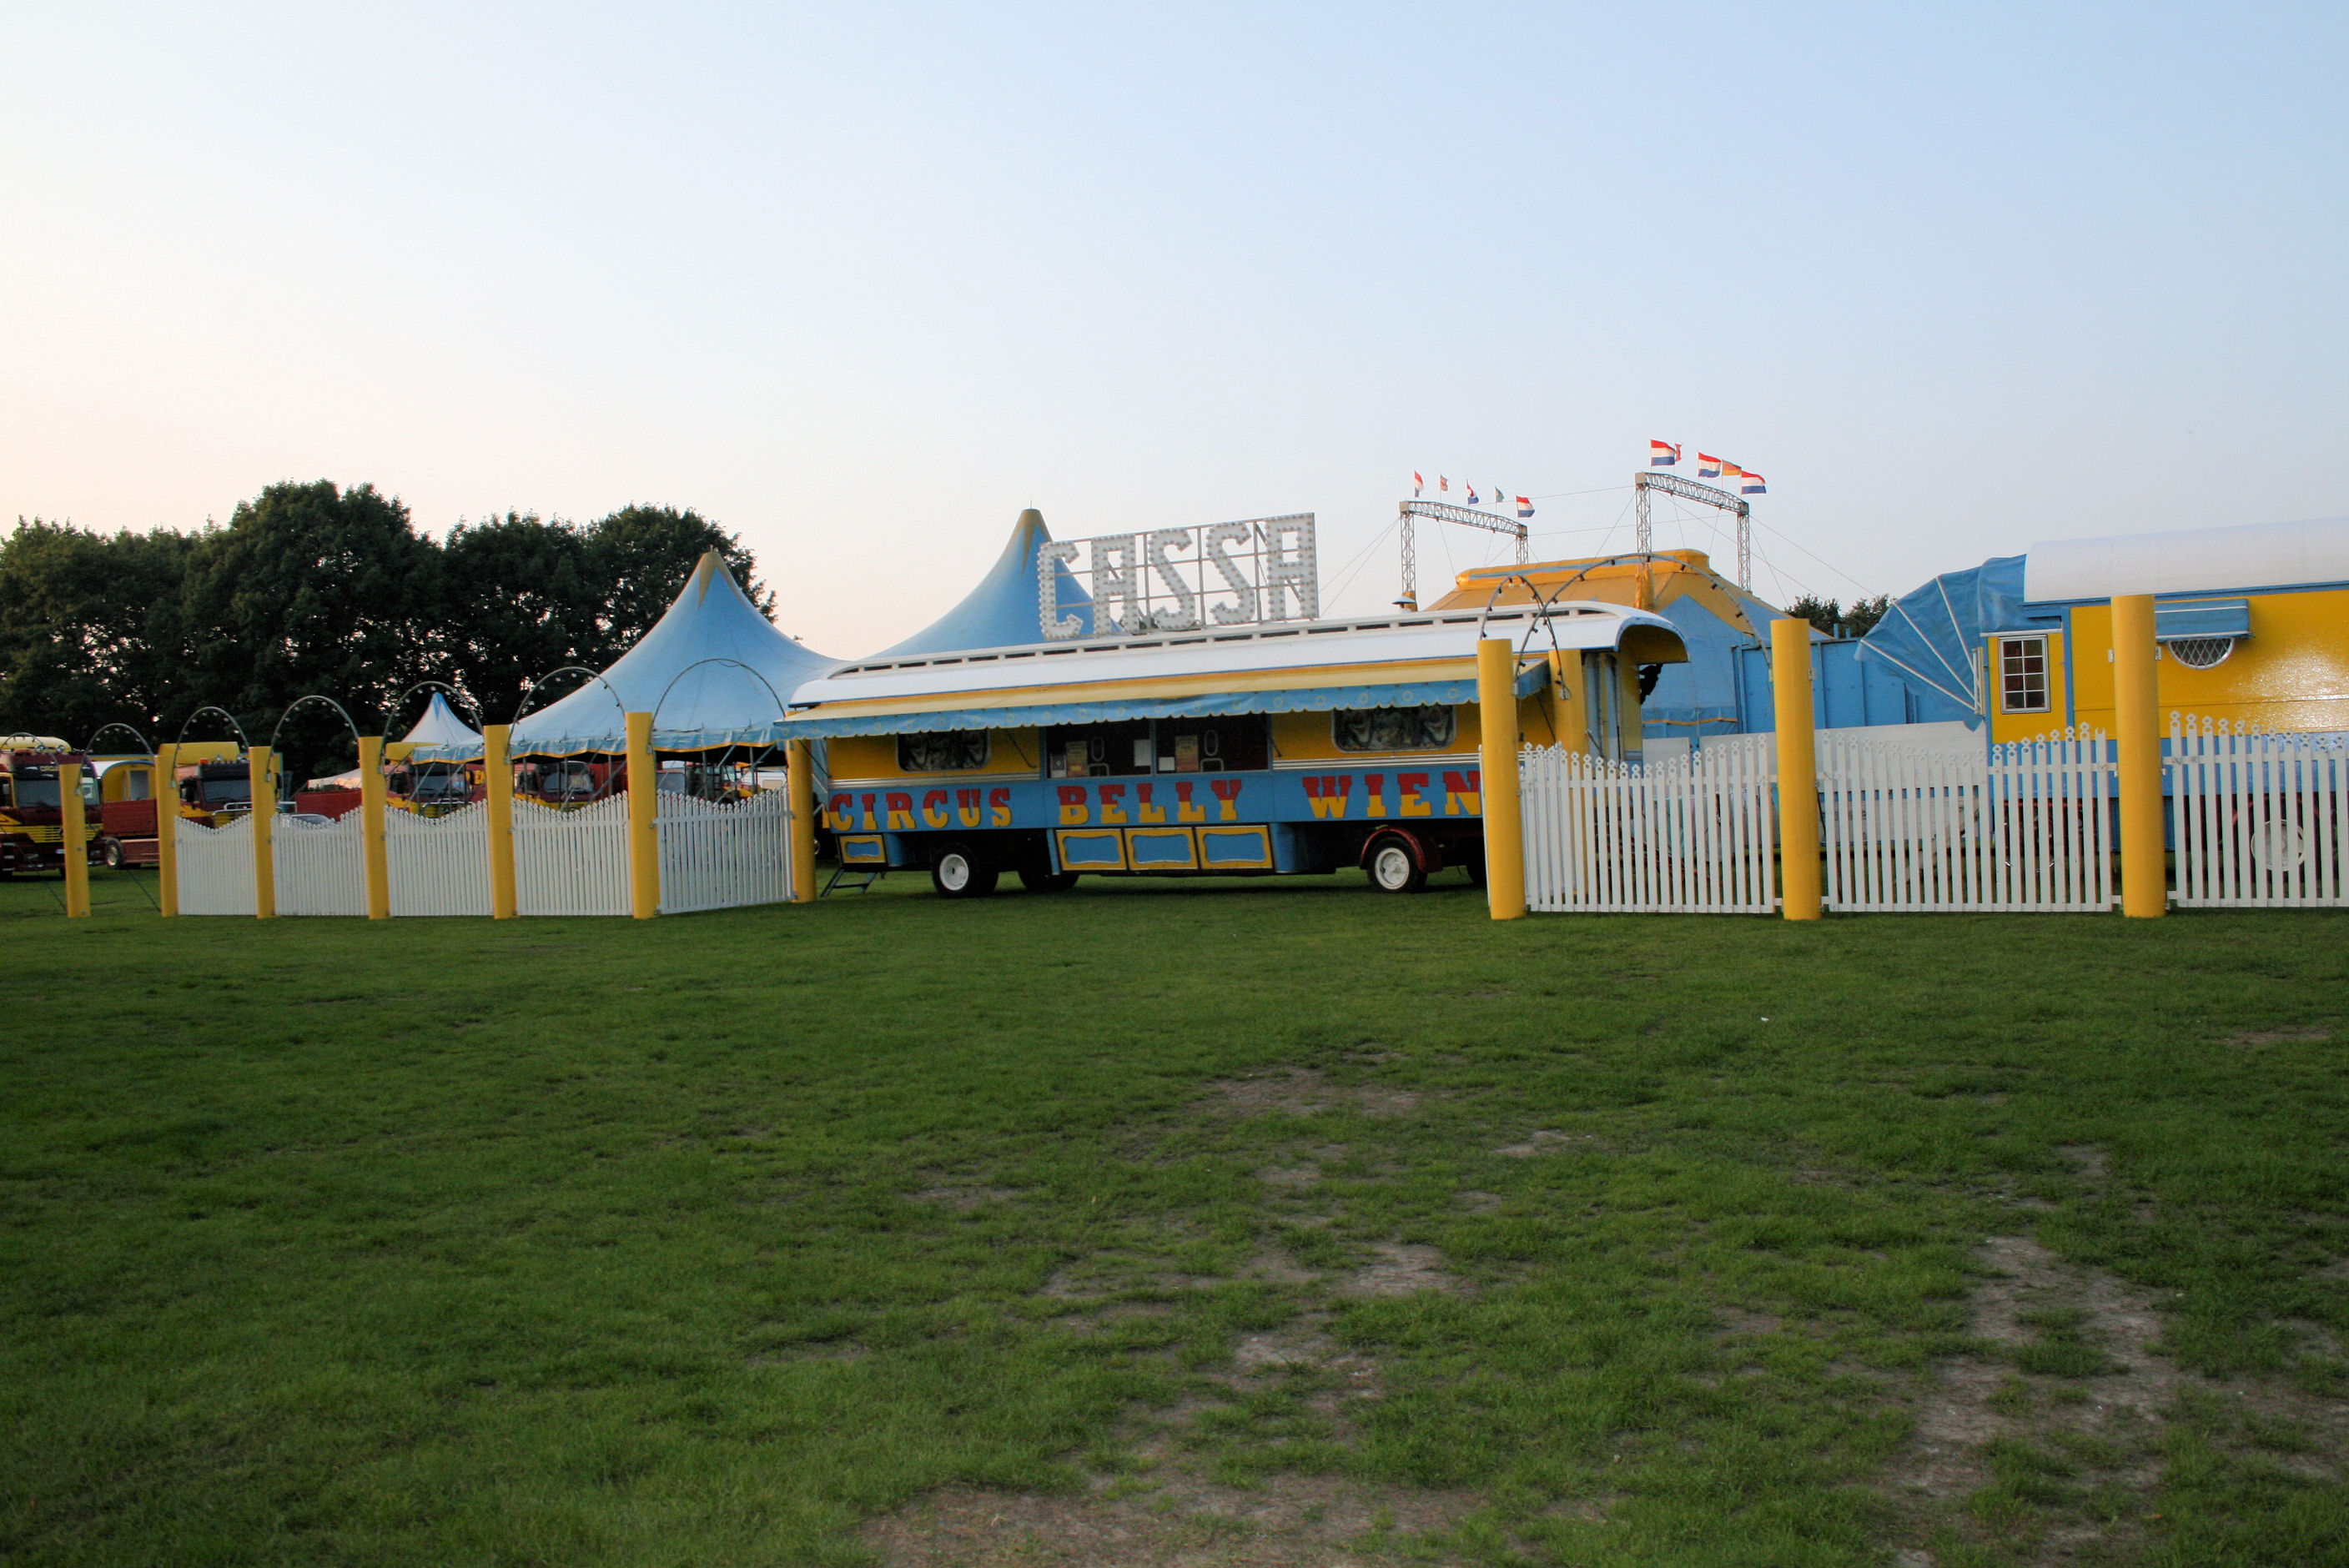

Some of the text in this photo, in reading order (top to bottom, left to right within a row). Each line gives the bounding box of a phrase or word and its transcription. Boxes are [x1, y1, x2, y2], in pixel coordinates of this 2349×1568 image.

[1039, 514, 1318, 641] CASSA
[829, 771, 1481, 831] CIRCUS BELLY WIEN
